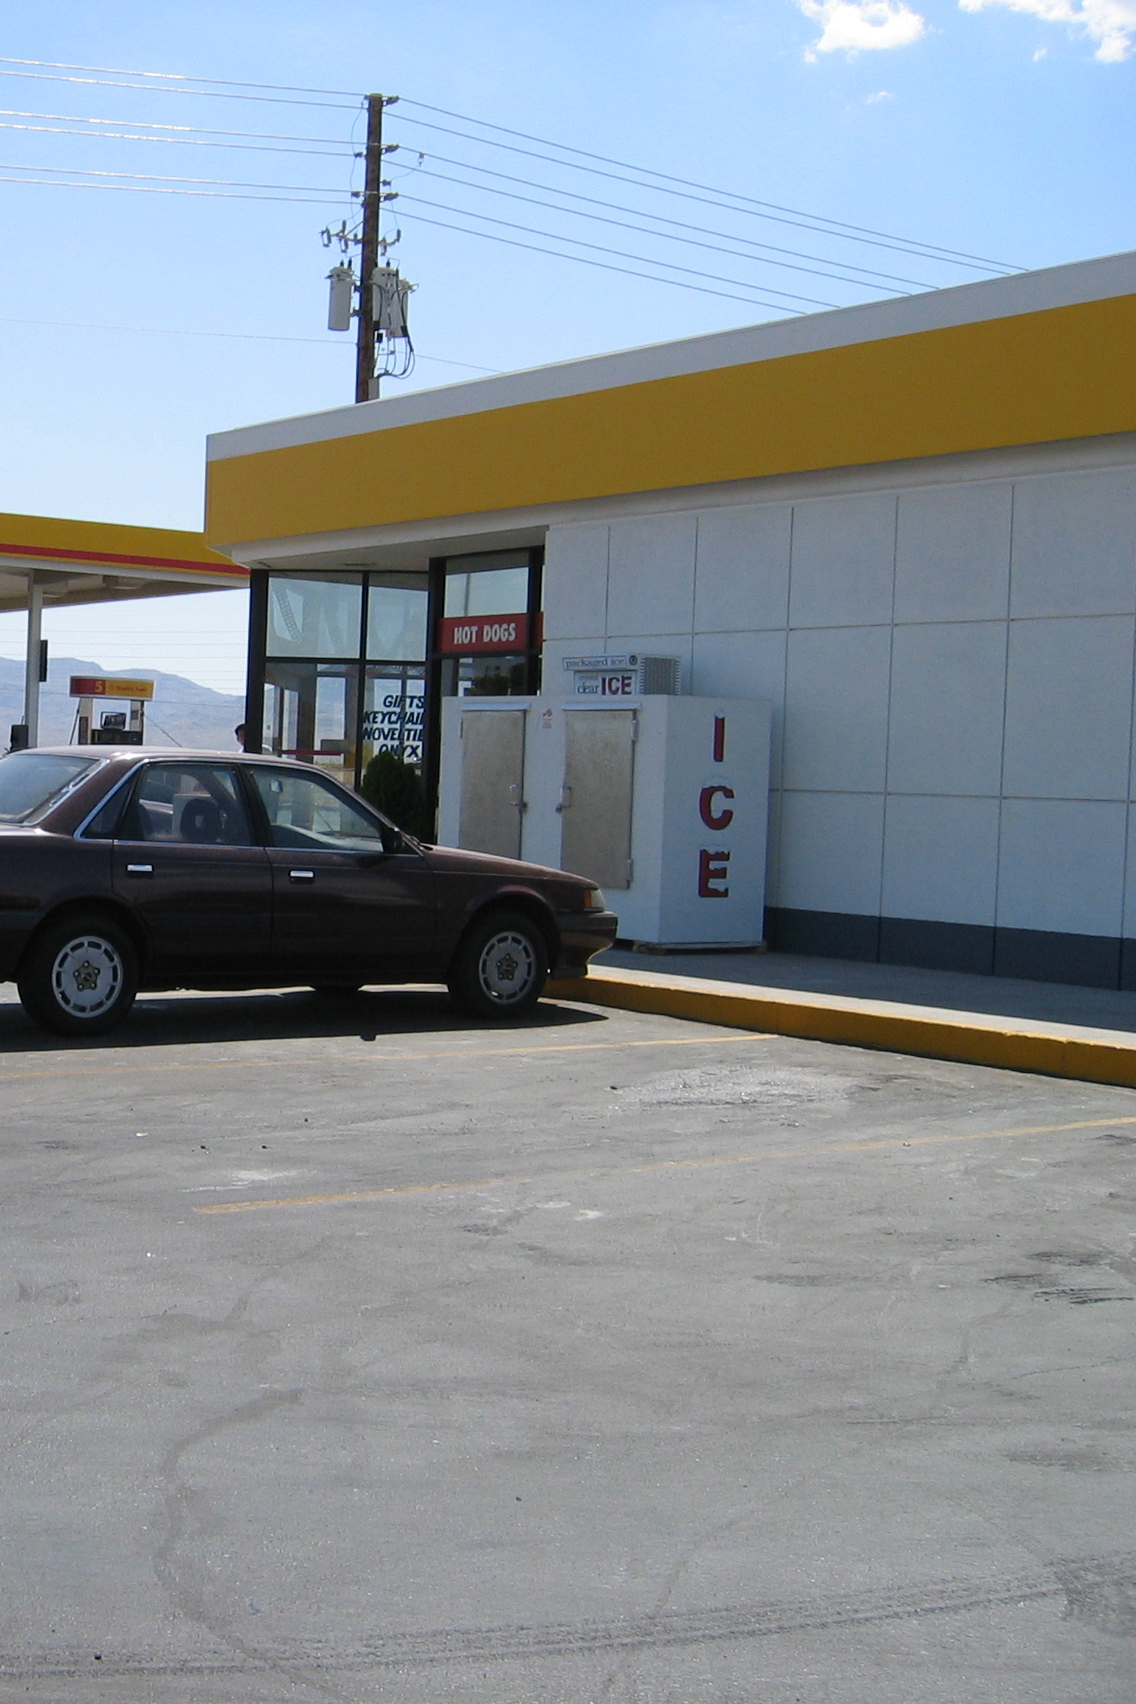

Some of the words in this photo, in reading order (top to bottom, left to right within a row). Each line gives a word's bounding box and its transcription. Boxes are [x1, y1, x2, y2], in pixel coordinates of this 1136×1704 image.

[453, 626, 479, 645] HOT
[483, 623, 517, 643] DOGS
[94, 681, 104, 693] 5
[601, 675, 633, 696] ICE
[382, 694, 425, 710] GIFTS
[697, 712, 736, 898] ICE
